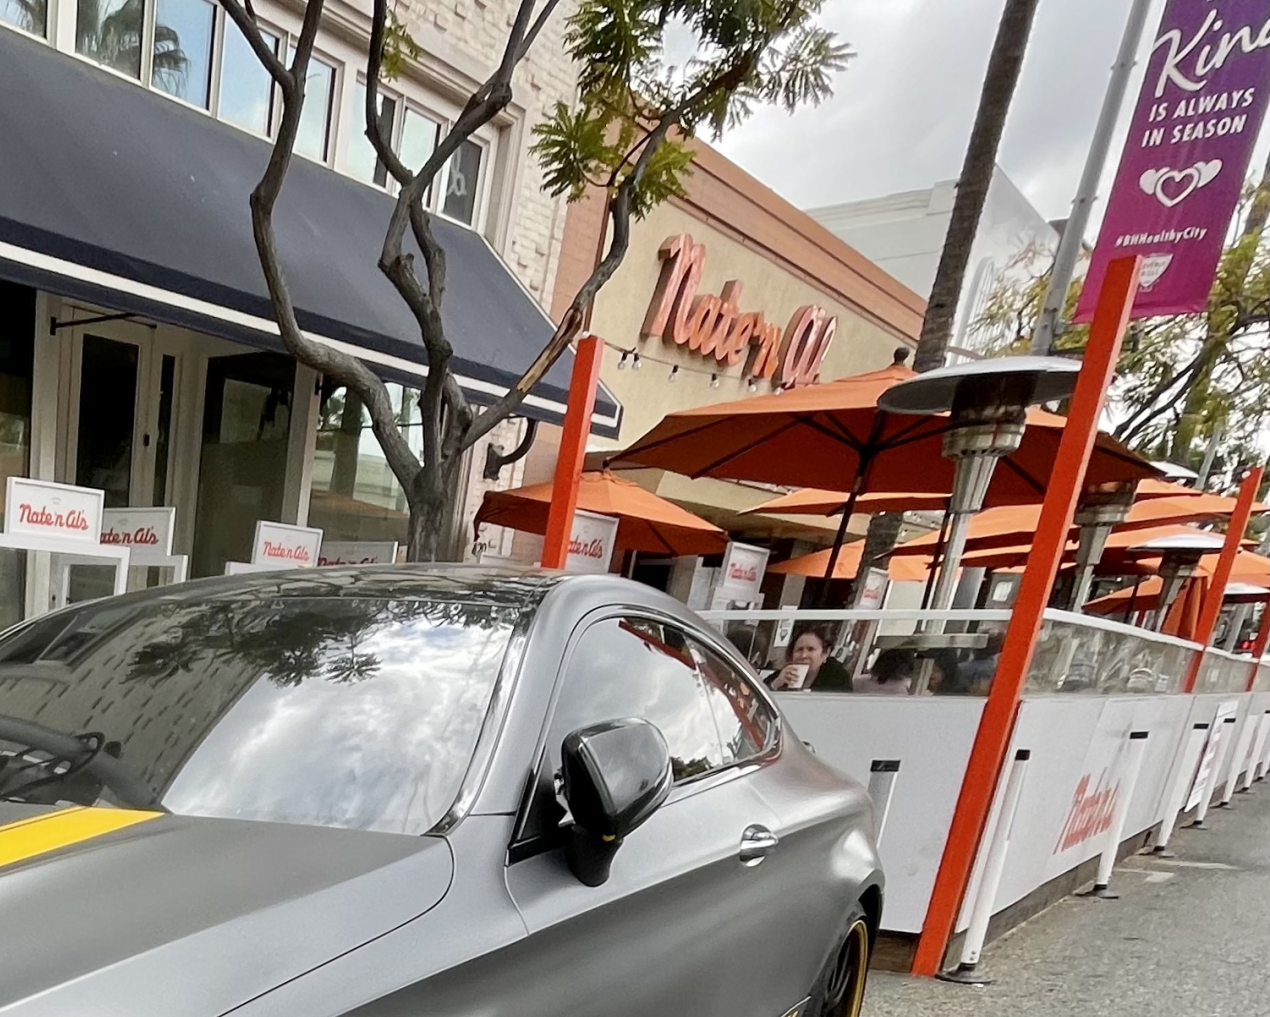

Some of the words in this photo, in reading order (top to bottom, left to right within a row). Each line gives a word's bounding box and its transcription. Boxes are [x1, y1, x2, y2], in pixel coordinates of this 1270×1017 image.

[1148, 102, 1168, 122] IS
[1172, 87, 1256, 119] ALWAYS
[1141, 127, 1165, 148] IN
[1170, 114, 1247, 144] SEASON
[1114, 226, 1208, 247] #BHHealthyCity
[642, 233, 754, 367] Nate
[19, 503, 53, 527] Nate
[65, 509, 89, 531] Al's
[100, 528, 121, 545] ate
[133, 525, 159, 545] Al's
[263, 541, 286, 558] Nate
